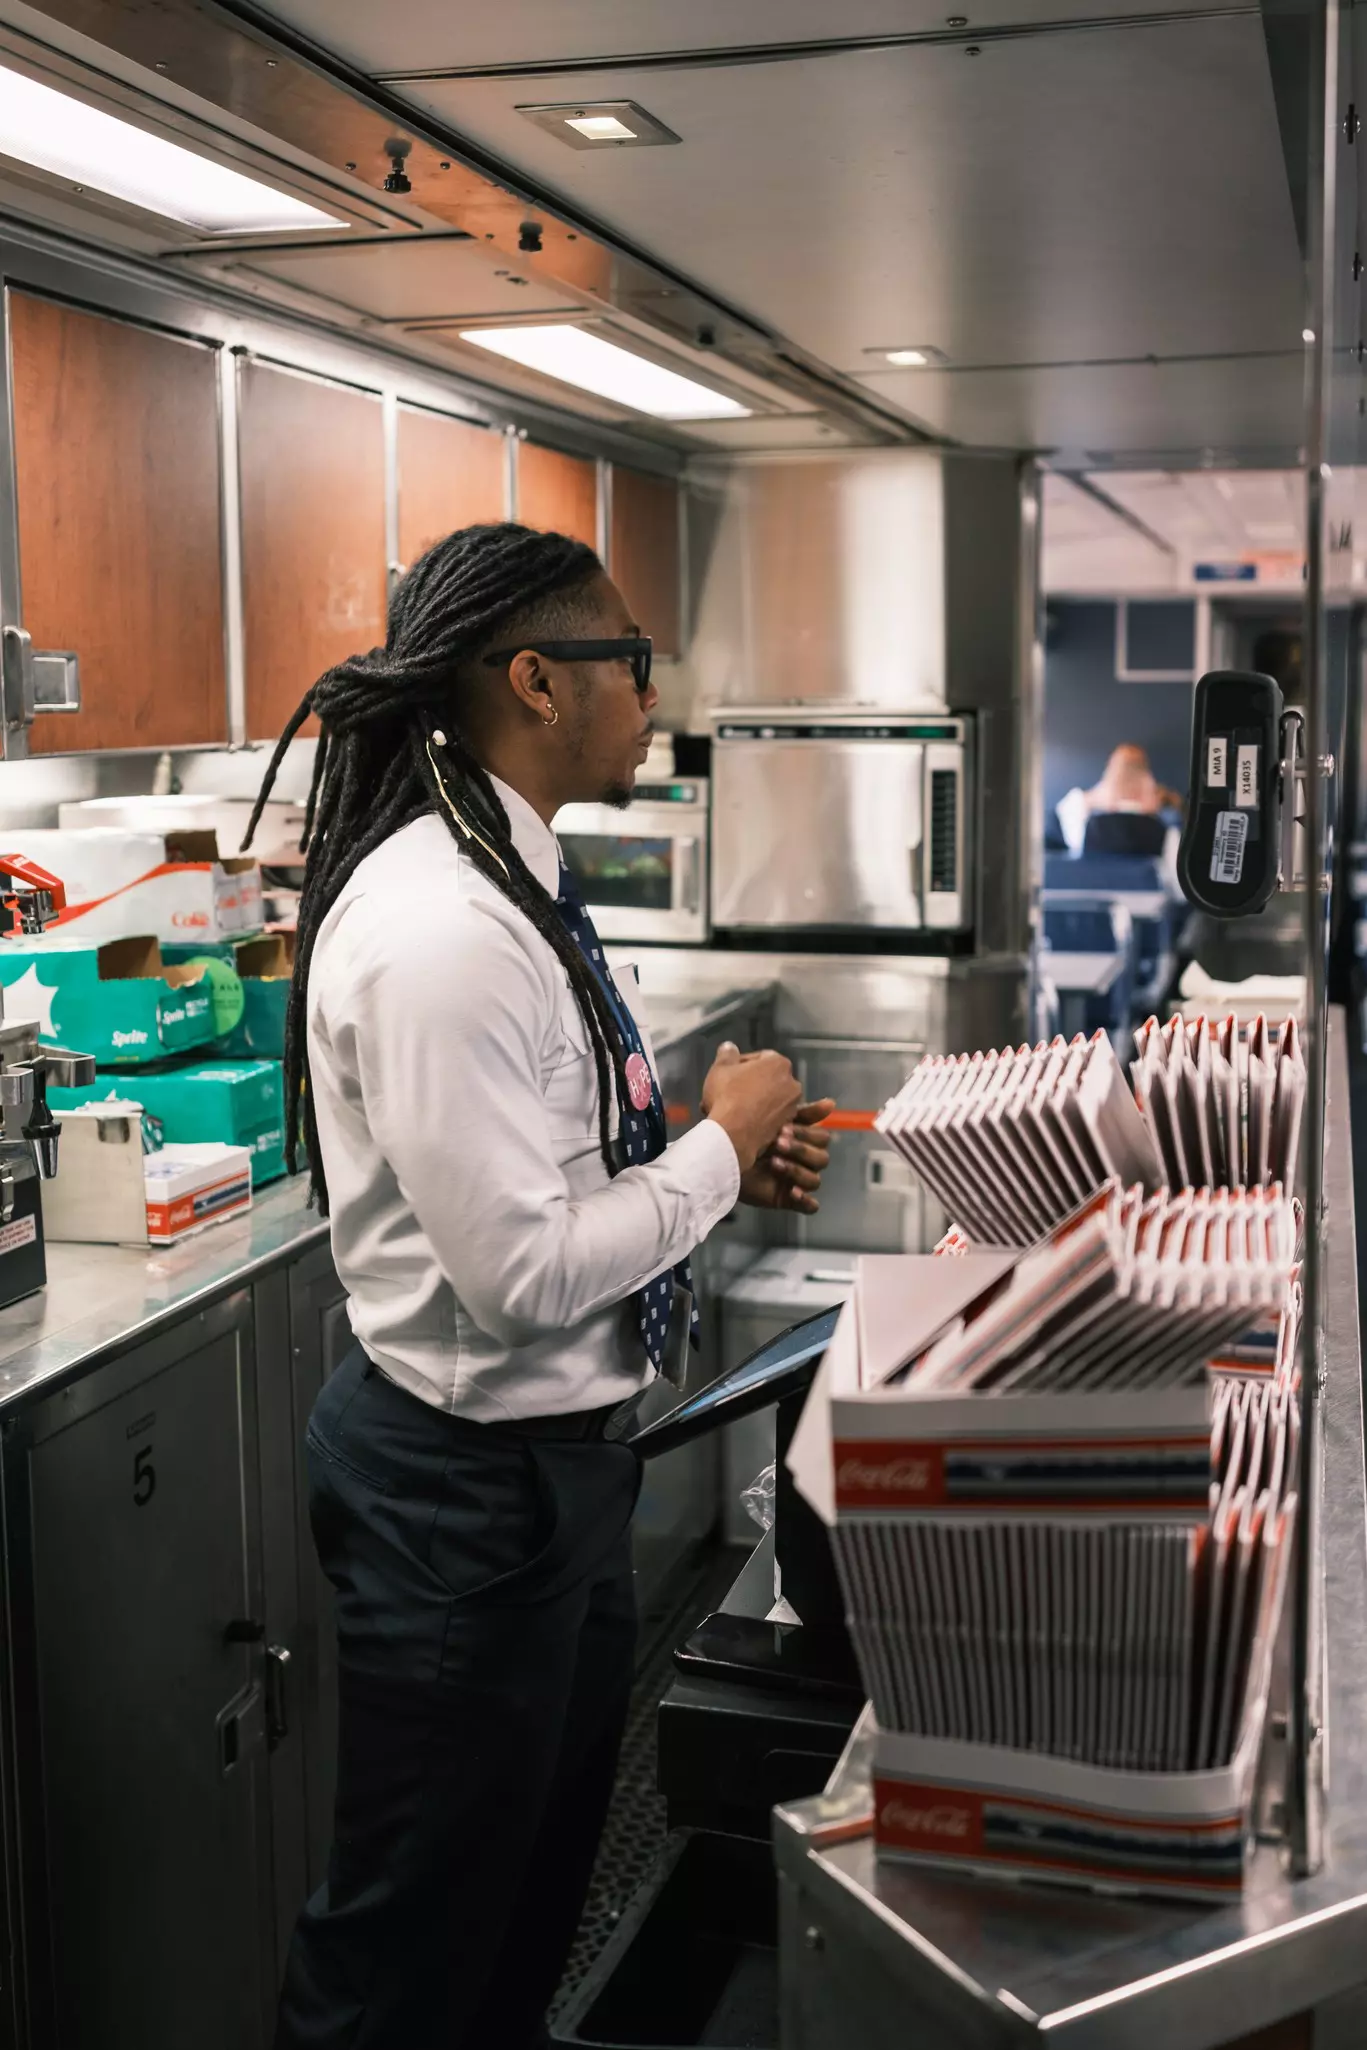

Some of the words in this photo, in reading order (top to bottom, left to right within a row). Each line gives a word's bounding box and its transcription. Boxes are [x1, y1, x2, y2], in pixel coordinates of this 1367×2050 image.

[1213, 755, 1222, 775] MIA
[162, 1008, 185, 1025] Sprite
[111, 1029, 148, 1048] Sprite
[133, 1444, 156, 1507] 5
